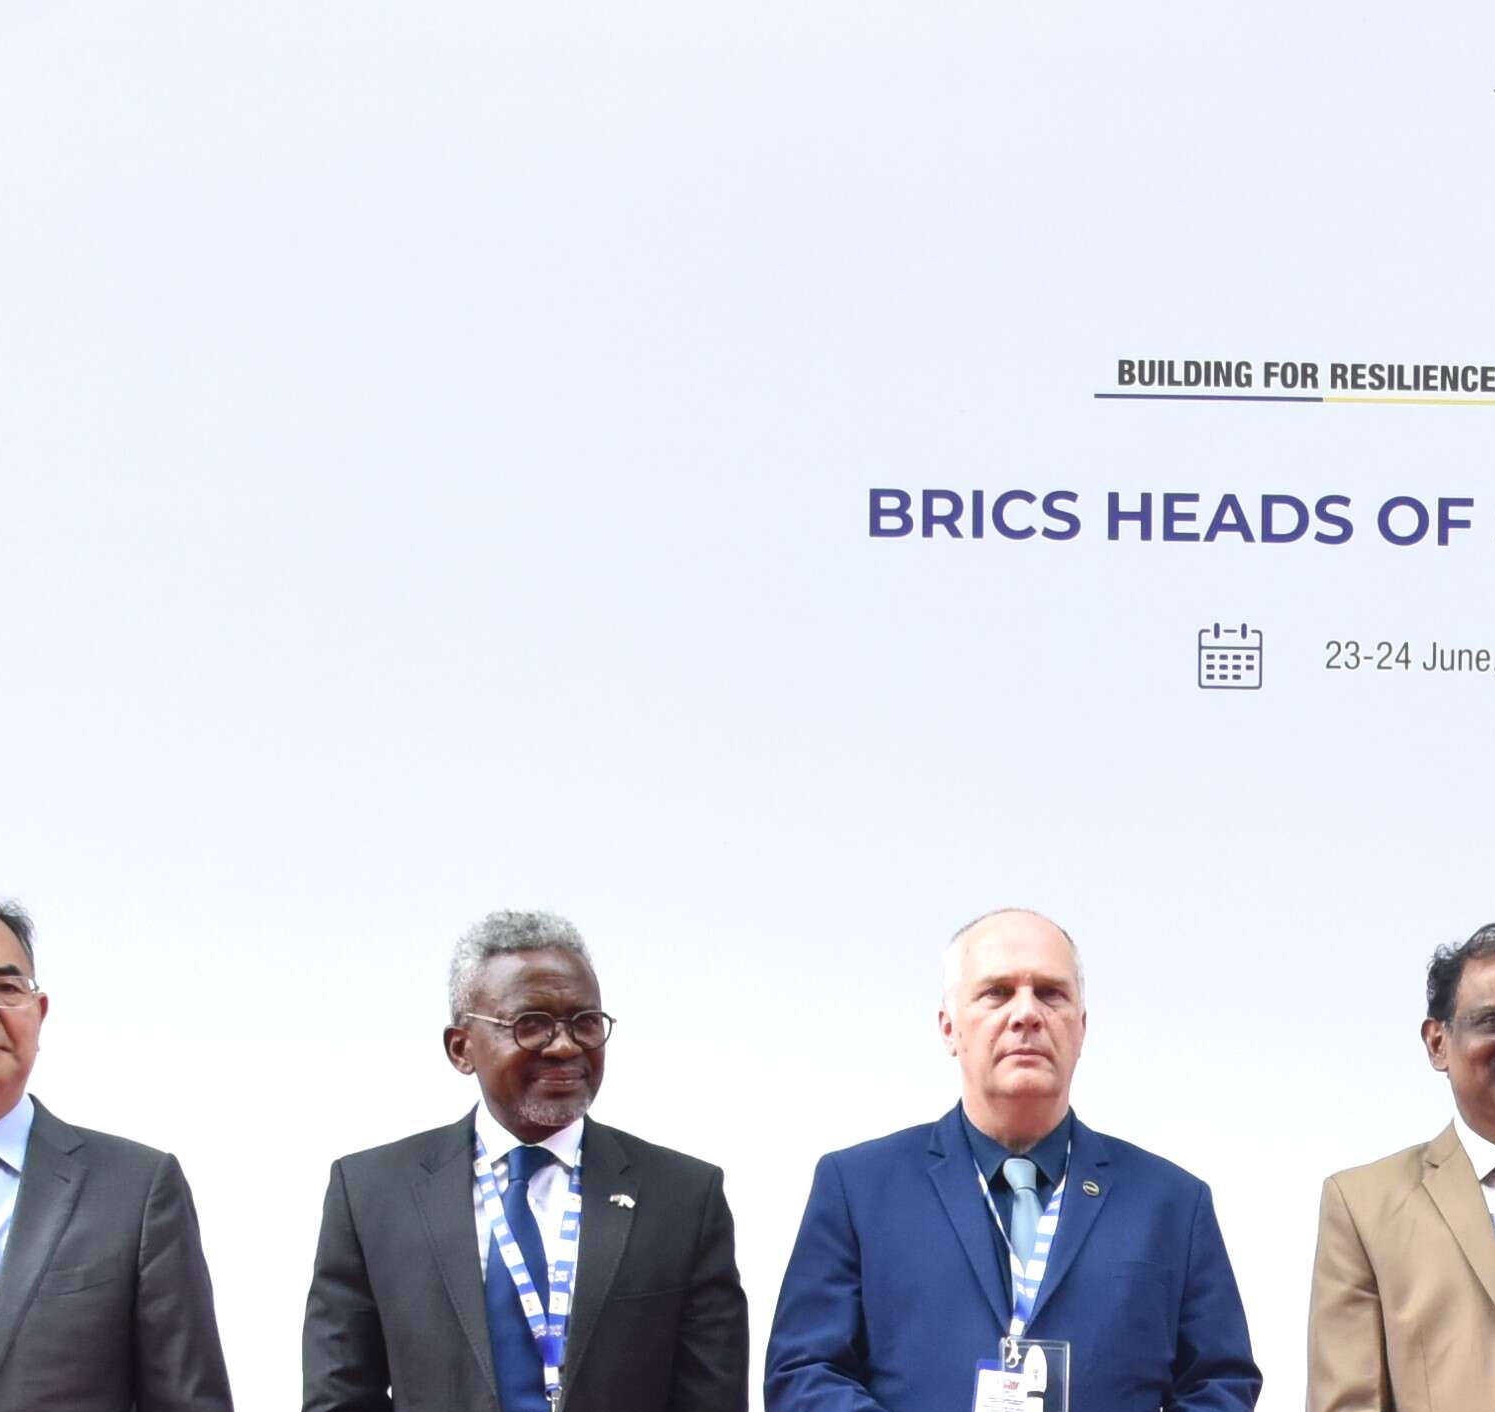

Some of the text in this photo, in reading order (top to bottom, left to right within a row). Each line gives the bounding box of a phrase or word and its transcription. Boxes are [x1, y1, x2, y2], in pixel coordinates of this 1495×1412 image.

[1117, 359, 1253, 388] BUILDING
[1263, 361, 1319, 389] FOR
[868, 487, 1082, 541] BRICS
[1107, 491, 1354, 546] HEADS
[1376, 495, 1475, 547] OF
[1325, 640, 1412, 671] 23-24
